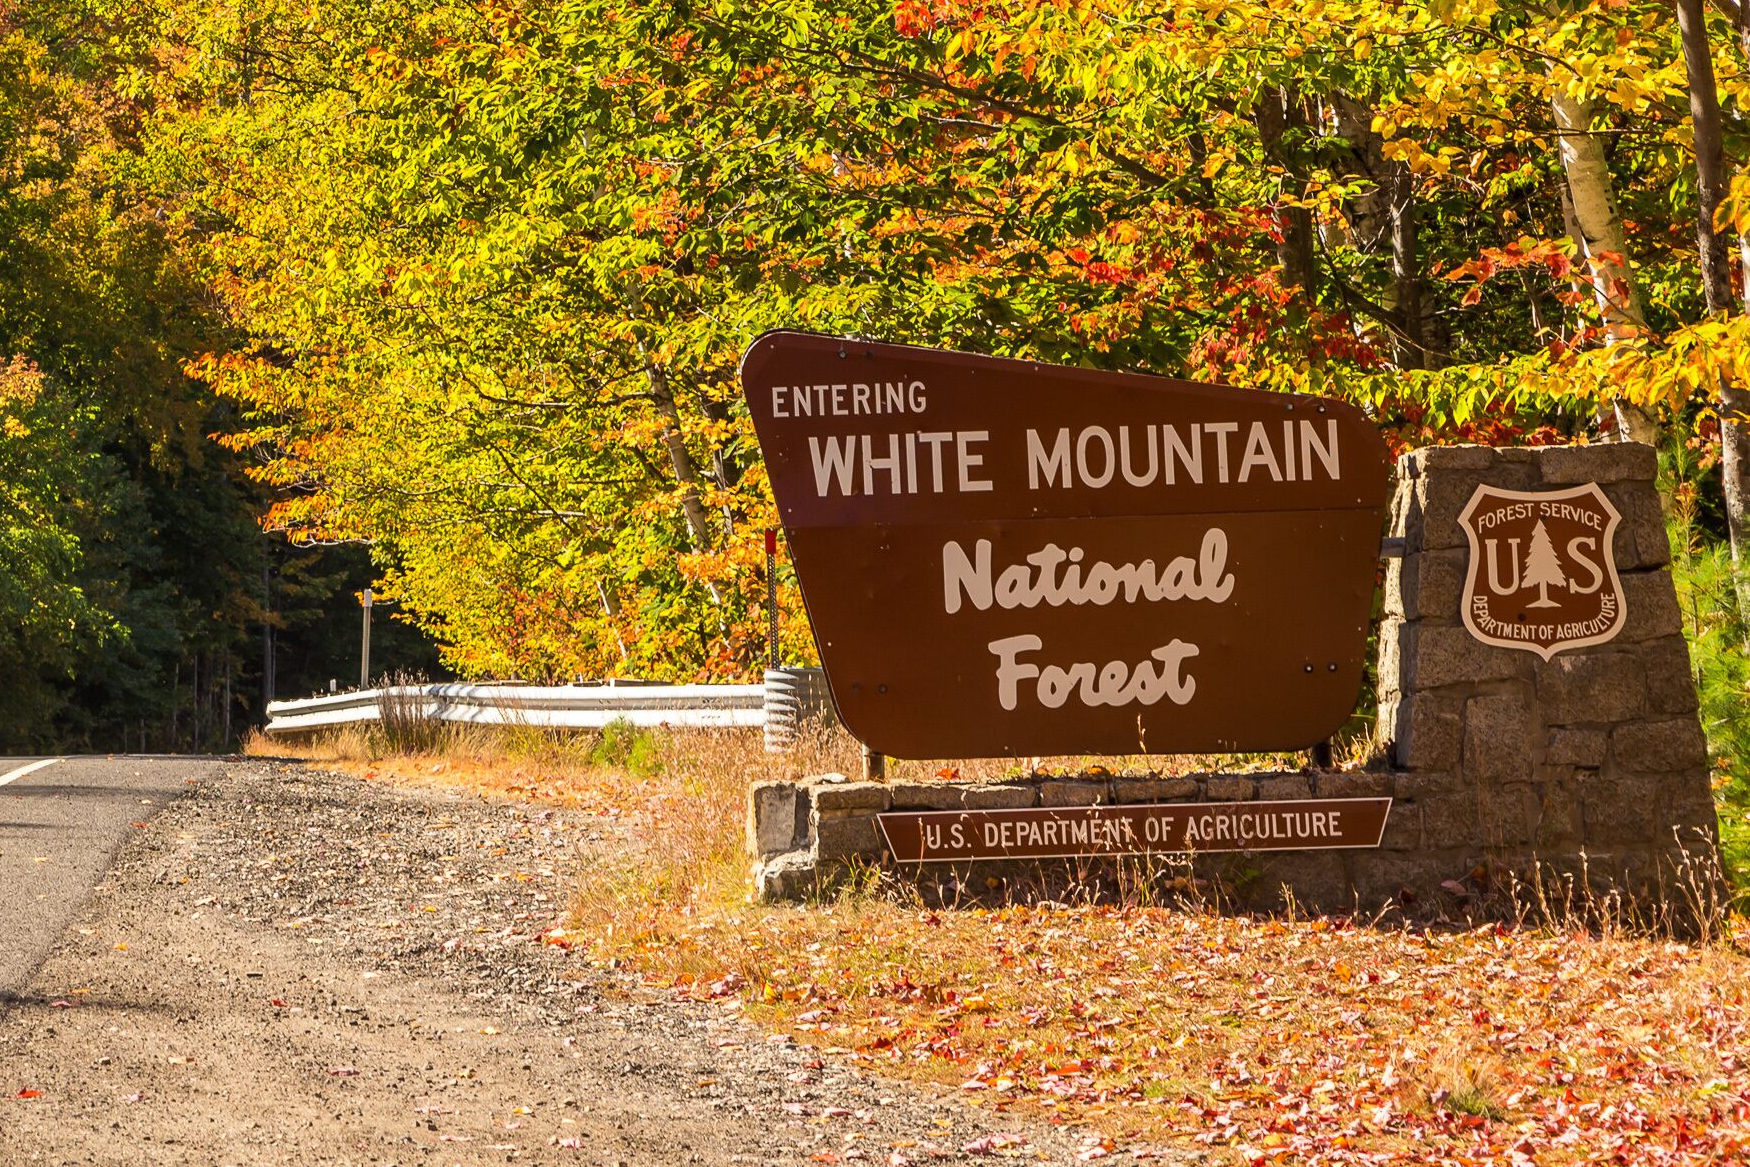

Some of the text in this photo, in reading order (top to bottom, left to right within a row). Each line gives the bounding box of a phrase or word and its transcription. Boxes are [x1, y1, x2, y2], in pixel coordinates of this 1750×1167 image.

[772, 381, 927, 418] ENTERING
[808, 419, 1341, 497] WHITE MOUNTAIN
[1478, 502, 1602, 534] FOREST SERVICE
[943, 527, 1235, 614] National
[1473, 592, 1616, 640] DEPARTMENT OF AGRICULTURE
[988, 634, 1200, 711] Forest
[926, 811, 1343, 849] U.S. DEPARTMENT OF AGRICULTURE
